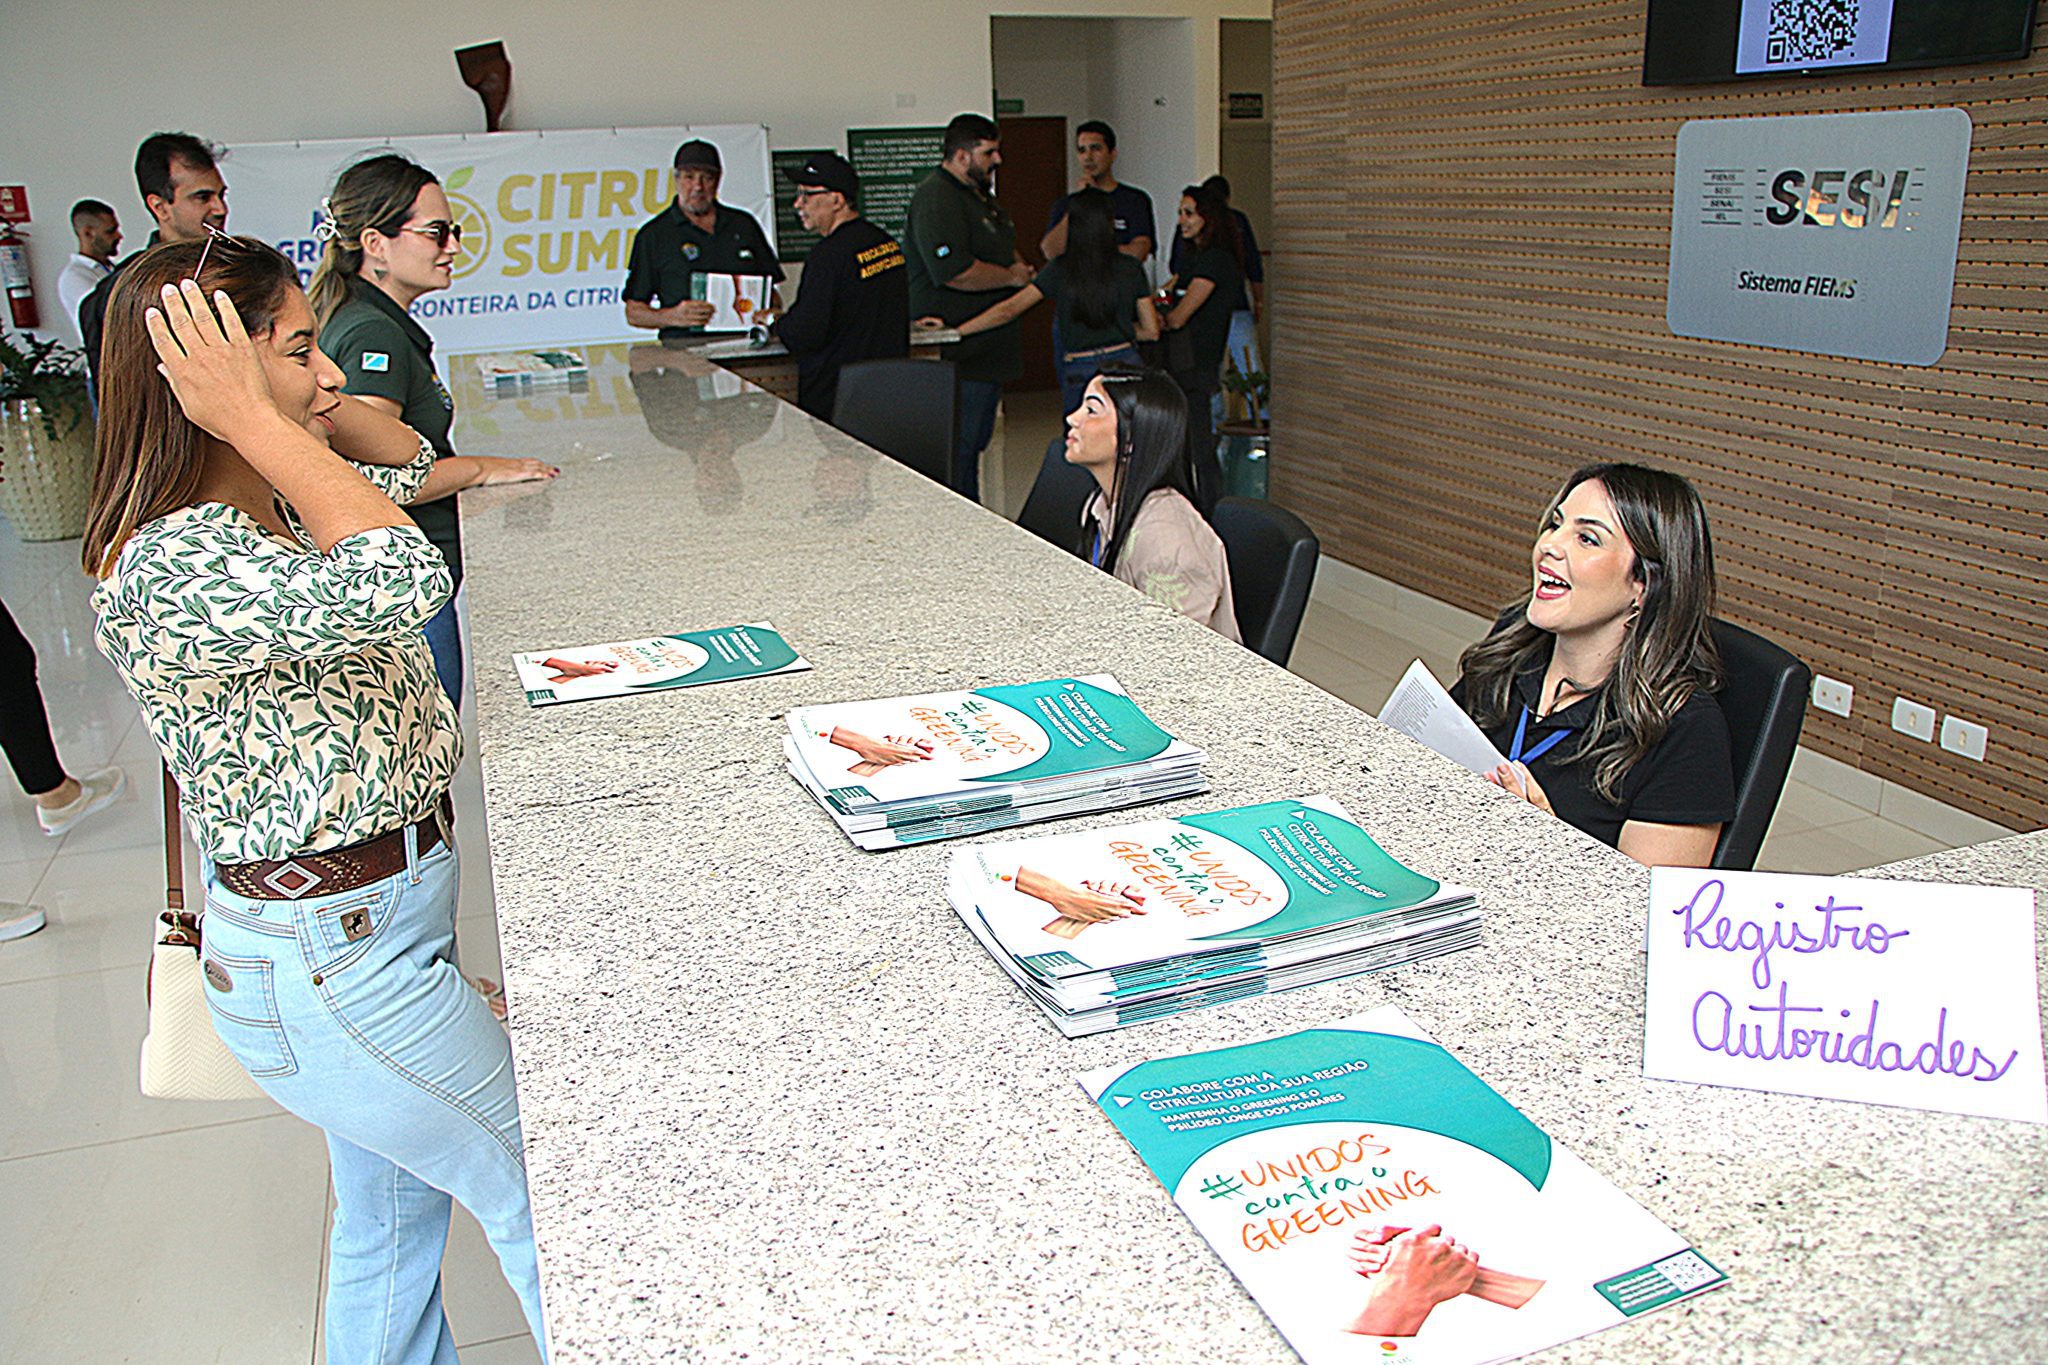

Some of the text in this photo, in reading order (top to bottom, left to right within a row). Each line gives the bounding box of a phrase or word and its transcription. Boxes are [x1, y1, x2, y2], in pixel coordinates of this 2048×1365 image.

[497, 167, 676, 223] CITRU
[1766, 168, 1910, 229] SESI
[502, 227, 635, 277] SUM
[408, 286, 622, 319] RONTEIRA DA CITRI
[1738, 270, 1857, 299] Sistema FIEMS
[945, 711, 987, 745] contra
[1153, 847, 1208, 895] contra
[1171, 832, 1272, 906] #UNIDOS
[1287, 823, 1335, 870] CITRICULTURA
[1330, 864, 1346, 877] DA
[1340, 875, 1361, 887] SUA
[1302, 821, 1341, 858] COLABORE
[1334, 855, 1359, 872] COM
[1109, 841, 1220, 918] GREENING
[1673, 879, 1910, 989] Registro
[1692, 981, 2018, 1081] Autoridades
[1140, 1071, 1275, 1101] COLABORE COM A
[1148, 1086, 1257, 1111] CITRICULTURA
[1255, 1081, 1282, 1094] DA
[1280, 1074, 1314, 1089] SUA
[1160, 1106, 1230, 1124] MANTENHA
[1228, 1104, 1241, 1113] O
[1241, 1093, 1300, 1111] GREENING
[1308, 1088, 1320, 1097] O
[1222, 1110, 1264, 1124] LONGE
[1262, 1105, 1290, 1117] DOS
[1289, 1093, 1346, 1113] POMARES
[1200, 1134, 1391, 1200] #UNIDOS
[1245, 1166, 1387, 1215] contra o
[1242, 1170, 1441, 1252] GREENING
